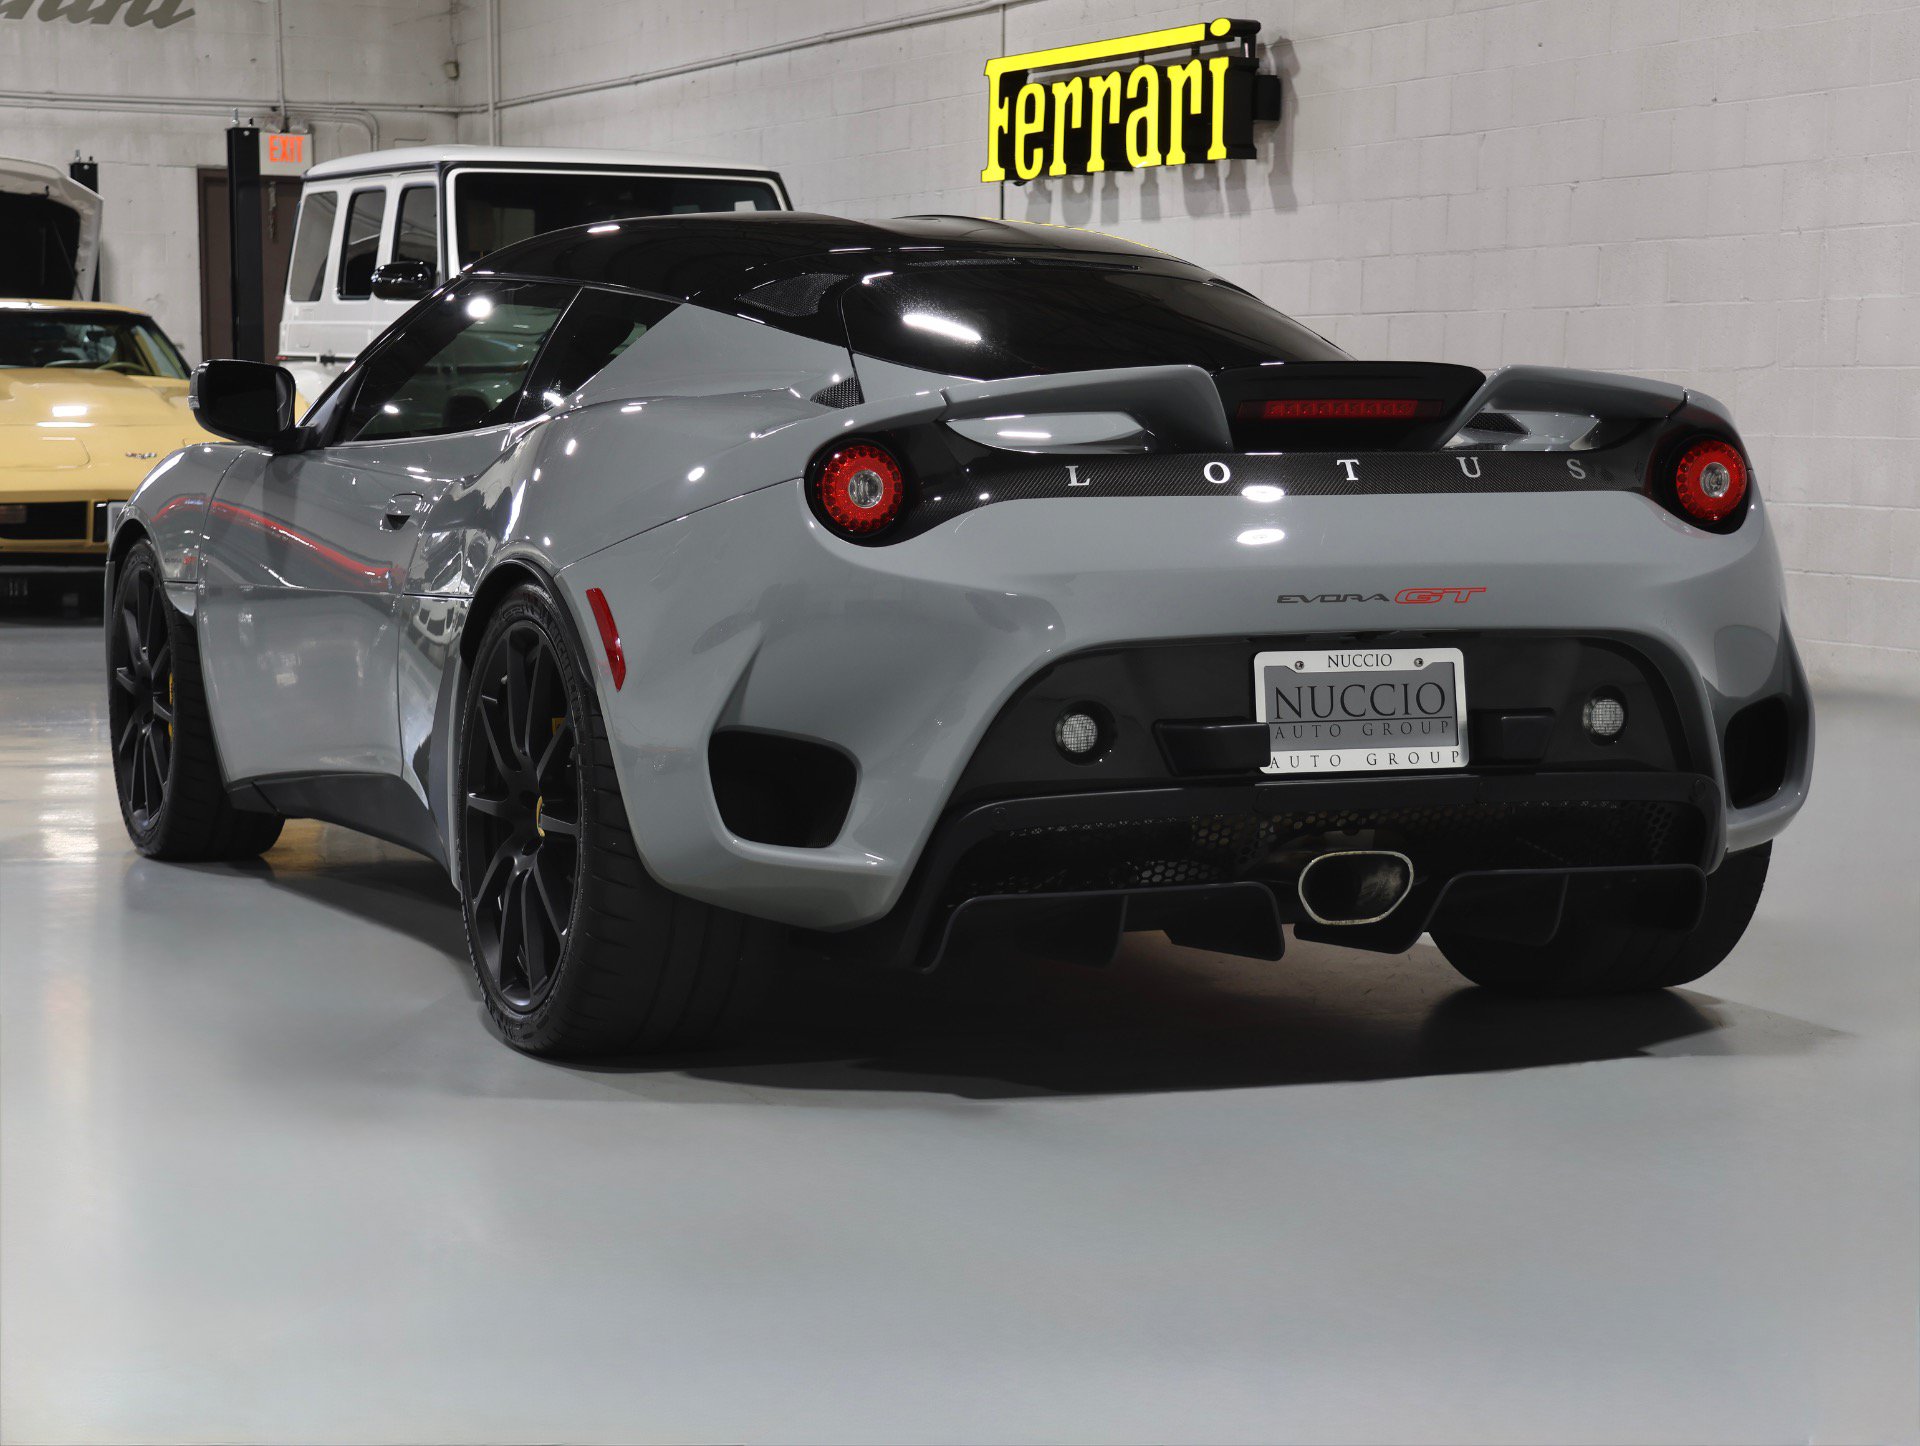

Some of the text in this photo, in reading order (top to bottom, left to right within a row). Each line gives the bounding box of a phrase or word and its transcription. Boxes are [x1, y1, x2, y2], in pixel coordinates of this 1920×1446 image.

[981, 17, 1232, 183] Ferrari
[269, 135, 304, 163] EXIT
[1277, 587, 1486, 604] EVORA GT
[1328, 654, 1392, 668] NUCCIO
[1275, 682, 1445, 719] NUCCIO
[1275, 721, 1448, 739] AUTO GROUP
[1270, 750, 1459, 769] AUTO GROUP
